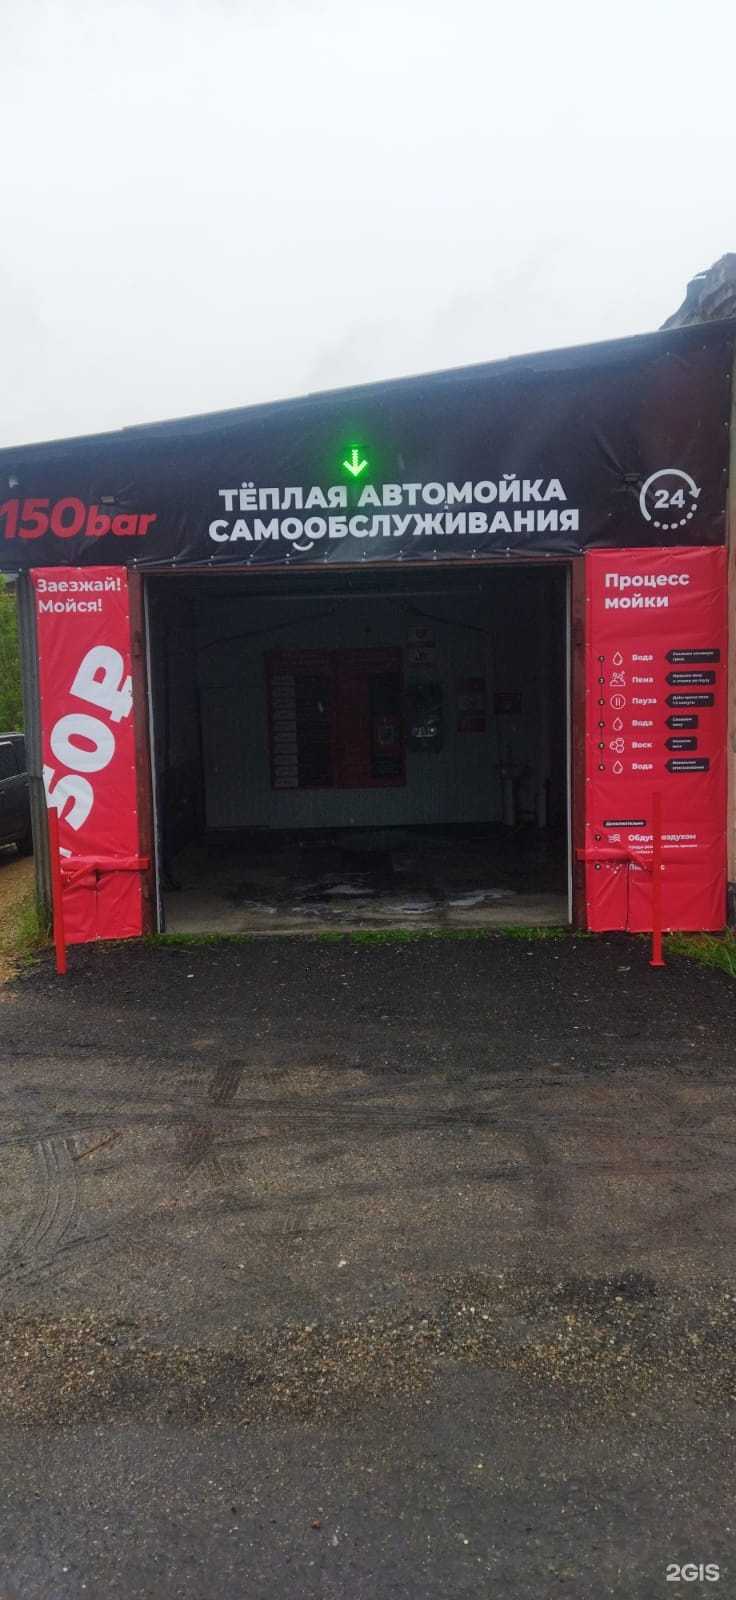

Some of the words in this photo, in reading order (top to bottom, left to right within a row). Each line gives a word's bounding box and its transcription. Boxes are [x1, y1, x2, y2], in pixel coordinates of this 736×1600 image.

[218, 482, 347, 511] ТЁПЛАЯ
[357, 473, 567, 508] АВТОМОЙКА
[654, 489, 686, 509] 24
[0, 496, 157, 539] 150bar
[208, 508, 580, 543] САМООБСЛУЖИВАНИЯ
[36, 578, 121, 593] Заезжай!
[604, 572, 690, 590] Процесс
[38, 598, 103, 614] Мойся!
[604, 594, 669, 609] мойки
[632, 653, 654, 662] Вода
[632, 676, 654, 684] Пена
[632, 697, 657, 706] Пауза
[632, 719, 654, 728] Вода
[632, 741, 653, 749] Воск
[632, 762, 654, 771] Вода
[661, 833, 696, 842] оздухом
